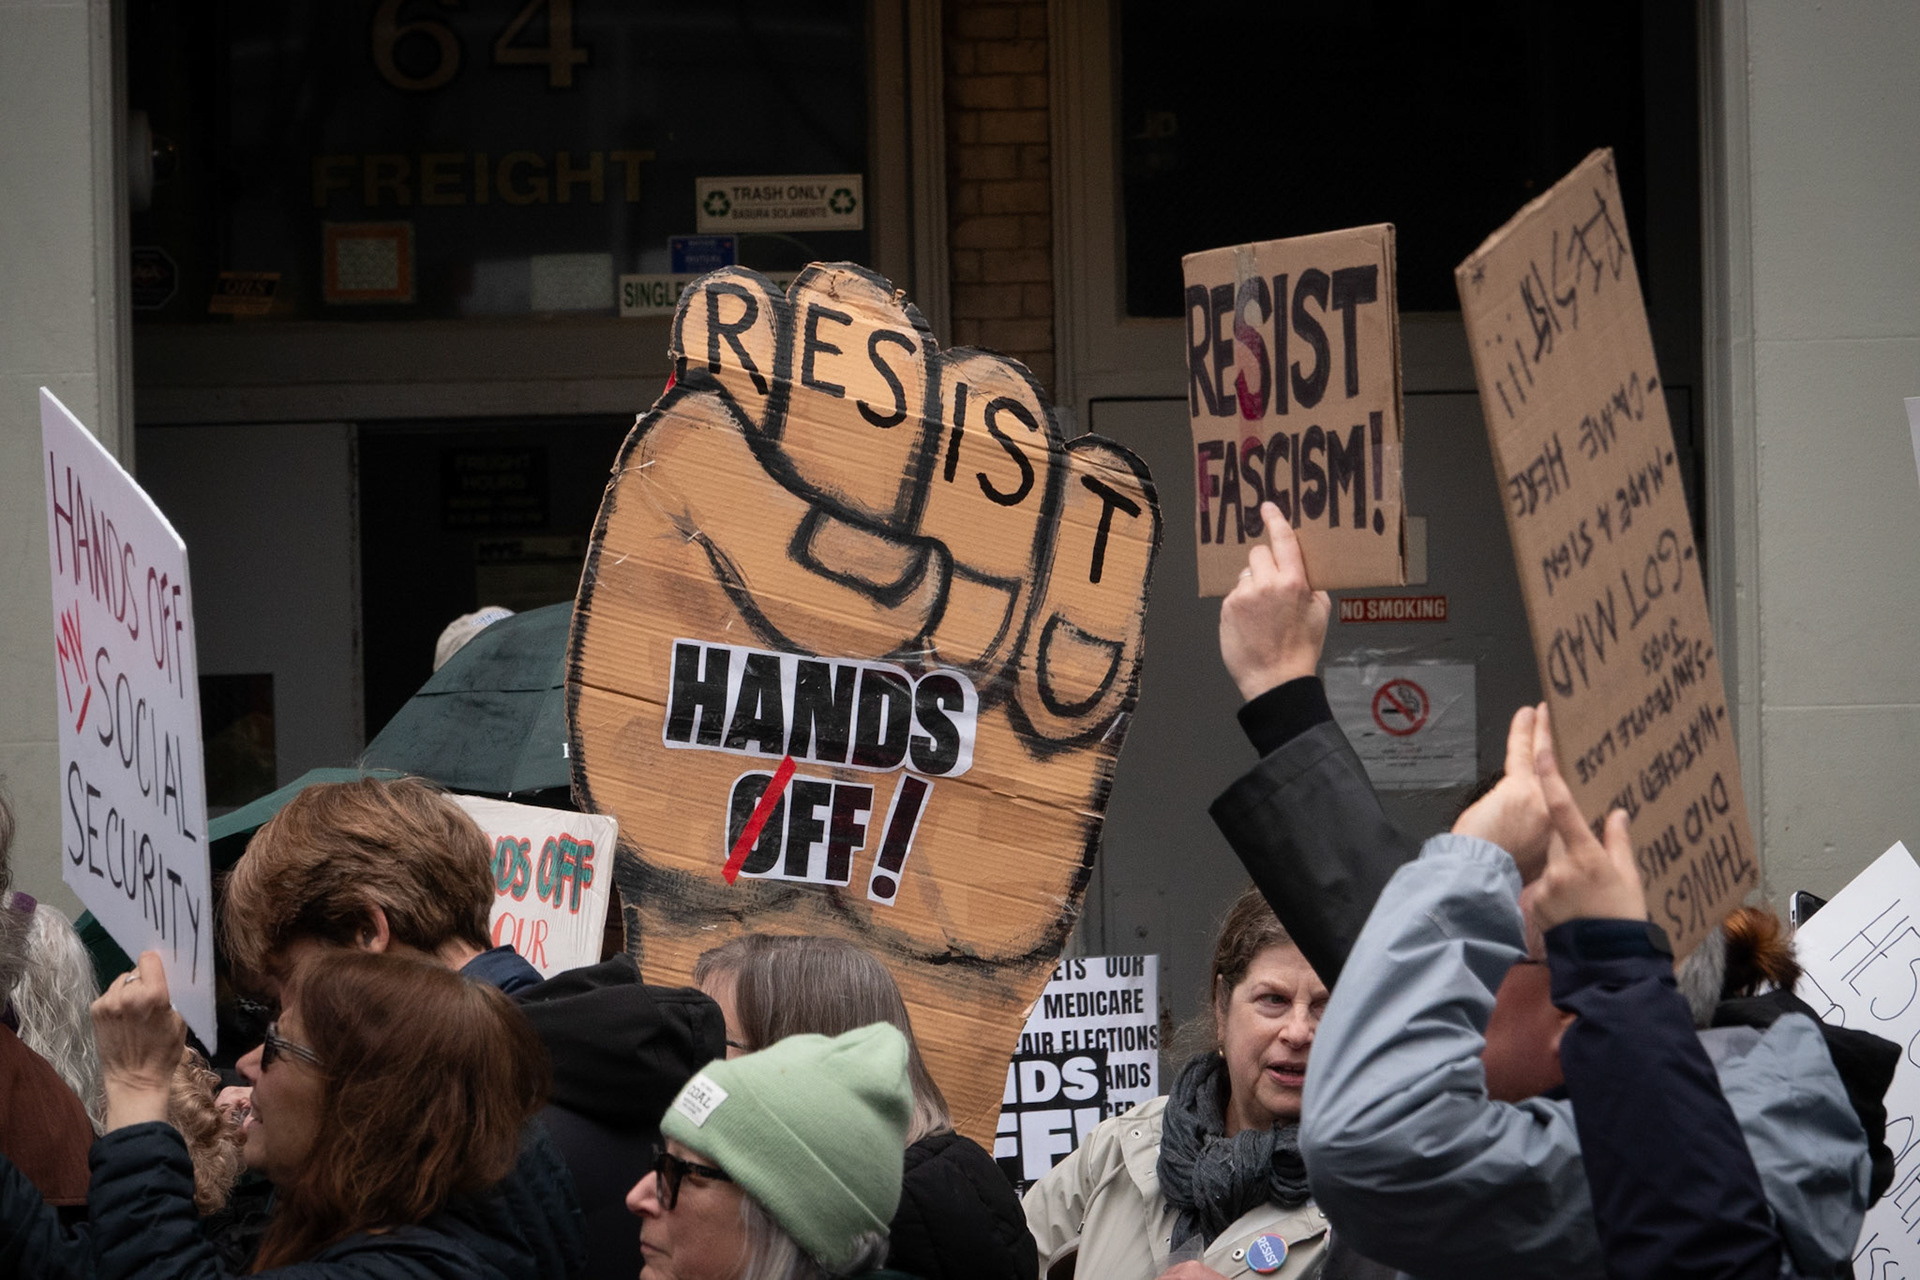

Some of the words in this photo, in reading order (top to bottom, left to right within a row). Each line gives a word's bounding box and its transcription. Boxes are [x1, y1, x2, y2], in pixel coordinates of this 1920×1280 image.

[370, 0, 589, 91] 64
[312, 150, 656, 208] FREIGHT
[732, 186, 783, 201] TRASH
[788, 185, 828, 200] ONLY
[1186, 264, 1378, 421] RESIST
[706, 282, 1141, 583] RESIST
[1198, 411, 1385, 544] FASCISM!
[50, 451, 139, 641] HANDS
[147, 566, 183, 699] OFF
[1341, 599, 1364, 620] NO
[1367, 598, 1446, 619] SMOKING
[1547, 582, 1618, 698] MAD
[95, 647, 197, 842] SOCIAL
[666, 643, 964, 775] HANDS
[728, 774, 929, 899] OFF!
[1684, 771, 1730, 846] DID
[67, 761, 200, 985] SECURITY
[484, 833, 532, 901] DS
[536, 832, 595, 914] OFF
[1664, 822, 1753, 941] THINGS
[492, 912, 548, 969] OUR
[1050, 958, 1087, 981] ETS
[1016, 1031, 1054, 1055] AIR
[1062, 1025, 1158, 1053] ELECTIONS
[1043, 989, 1144, 1019] MEDICARE
[1257, 1236, 1280, 1266] RESIST
